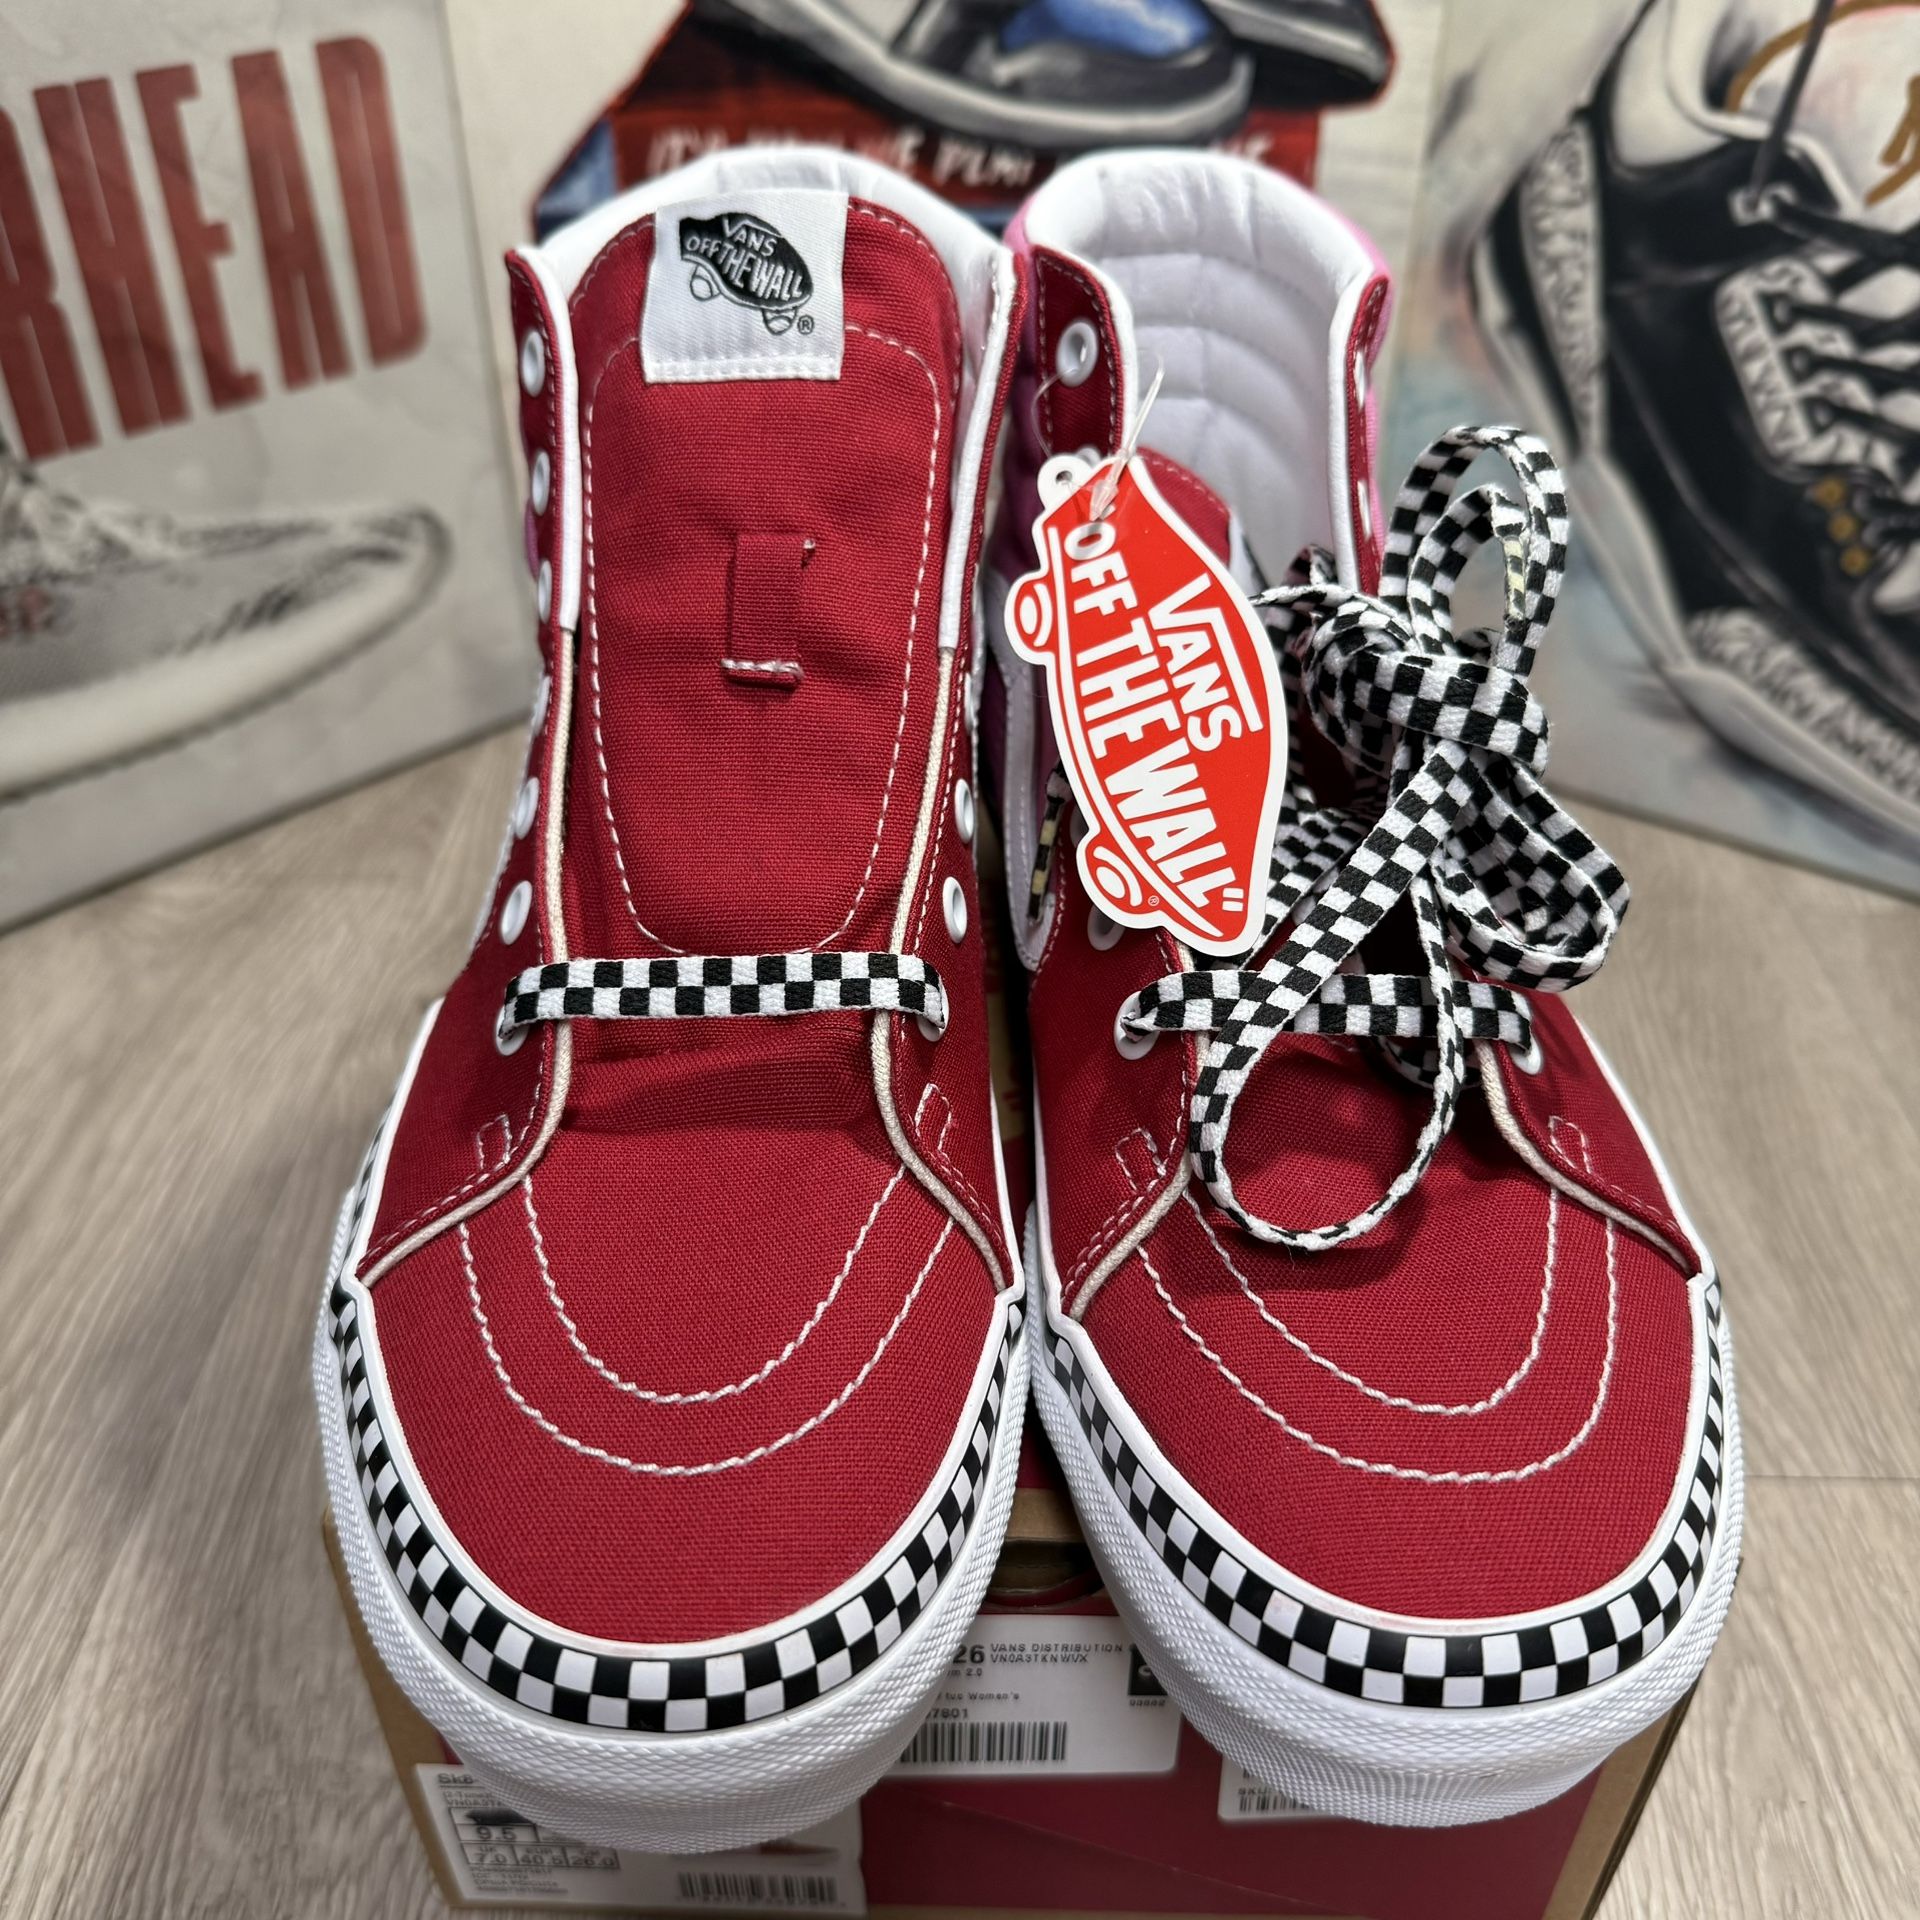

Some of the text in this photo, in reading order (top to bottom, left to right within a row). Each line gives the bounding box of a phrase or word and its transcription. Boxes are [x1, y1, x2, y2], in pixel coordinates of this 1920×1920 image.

[722, 218, 782, 257] VANS
[686, 236, 803, 301] OFF THE WALL
[1075, 616, 1181, 760] THE
[1148, 572, 1264, 753] VANS
[991, 1643, 1026, 1652] VANS
[1031, 1643, 1123, 1652] DISTRIBUTION
[476, 1826, 517, 1841] 9.5
